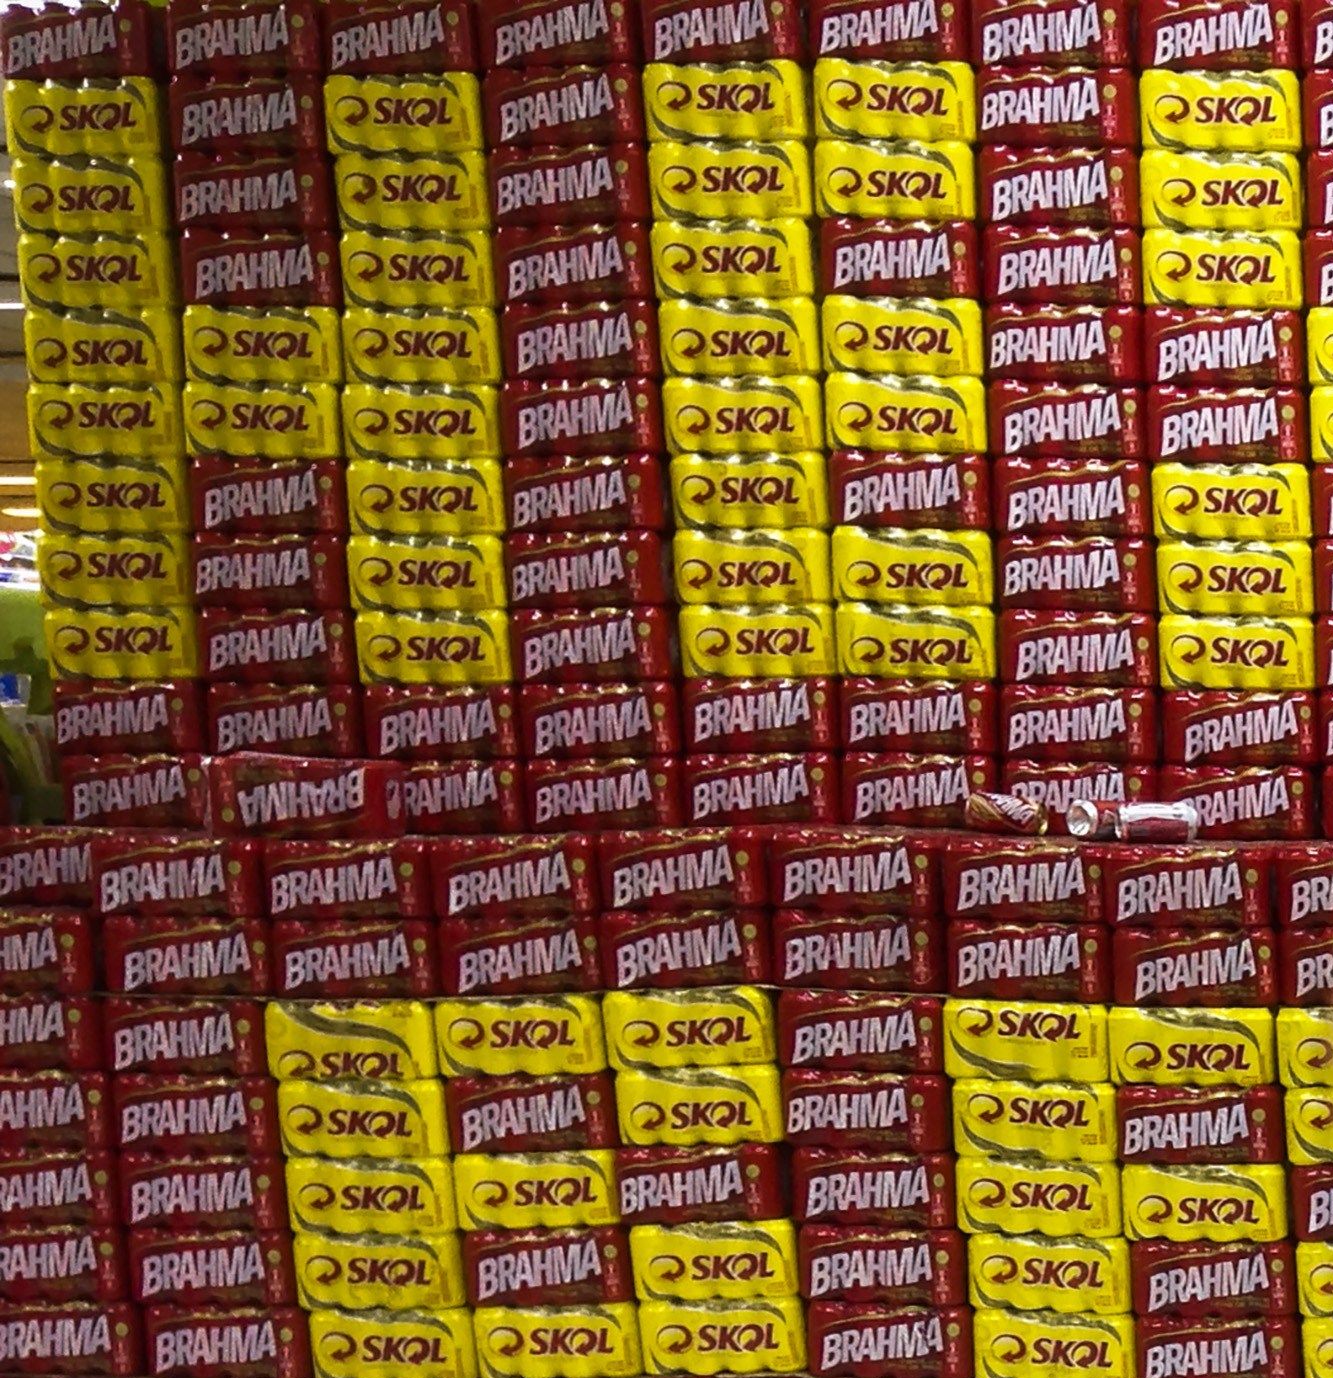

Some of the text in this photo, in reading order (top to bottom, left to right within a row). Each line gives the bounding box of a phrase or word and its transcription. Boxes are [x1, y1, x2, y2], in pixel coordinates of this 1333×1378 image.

[332, 5, 444, 69] BRAHMA
[1154, 2, 1273, 65] BRAHMA
[61, 103, 136, 130] SKOL
[700, 83, 774, 113] SKOL
[982, 77, 1099, 129] BRAHMA
[180, 170, 297, 221] BRAHMA
[498, 157, 613, 214] BRAHMA
[867, 171, 946, 200] SKOL
[67, 255, 141, 284] SKOL
[389, 254, 469, 283] SKOL
[704, 246, 780, 274] SKOL
[998, 240, 1117, 294] BRAHMA
[233, 331, 312, 360] SKOL
[518, 313, 633, 372] BRAHMA
[874, 326, 952, 354] SKOL
[1158, 320, 1276, 381] BRAHMA
[81, 401, 155, 430] SKOL
[395, 410, 475, 437] SKOL
[718, 407, 794, 434] SKOL
[1005, 394, 1121, 453] BRAHMA
[514, 470, 626, 527] BRAHMA
[844, 464, 960, 521] BRAHMA
[196, 548, 310, 594] BRAHMA
[399, 560, 475, 589] SKOL
[717, 561, 797, 587] SKOL
[1005, 549, 1119, 595] BRAHMA
[1208, 566, 1286, 595] SKOL
[525, 612, 636, 678] BRAHMA
[890, 639, 972, 666] SKOL
[50, 694, 168, 743] BRAHMA
[381, 699, 496, 754] BRAHMA
[1185, 698, 1303, 761] BRAHMA
[238, 768, 366, 827] BRAHMA
[694, 760, 809, 819] BRAHMA
[101, 854, 225, 912] BRAHMA
[449, 852, 570, 915] BRAHMA
[958, 857, 1085, 910] BRAHMA
[286, 934, 410, 989] BRAHMA
[785, 925, 911, 979] BRAHMA
[1135, 939, 1256, 1000] BRAHMA
[492, 1020, 574, 1049] SKOL
[998, 1011, 1080, 1042] SKOL
[122, 1092, 246, 1143] BRAHMA
[675, 1101, 752, 1129] SKOL
[1124, 1104, 1249, 1154] BRAHMA
[343, 1186, 424, 1212] SKOL
[1012, 1182, 1092, 1211] SKOL
[143, 1243, 265, 1296] BRAHMA
[811, 1244, 932, 1296] BRAHMA
[1149, 1253, 1269, 1312] BRAHMA
[531, 1328, 613, 1356] SKOL
[1032, 1338, 1112, 1368] SKOL
